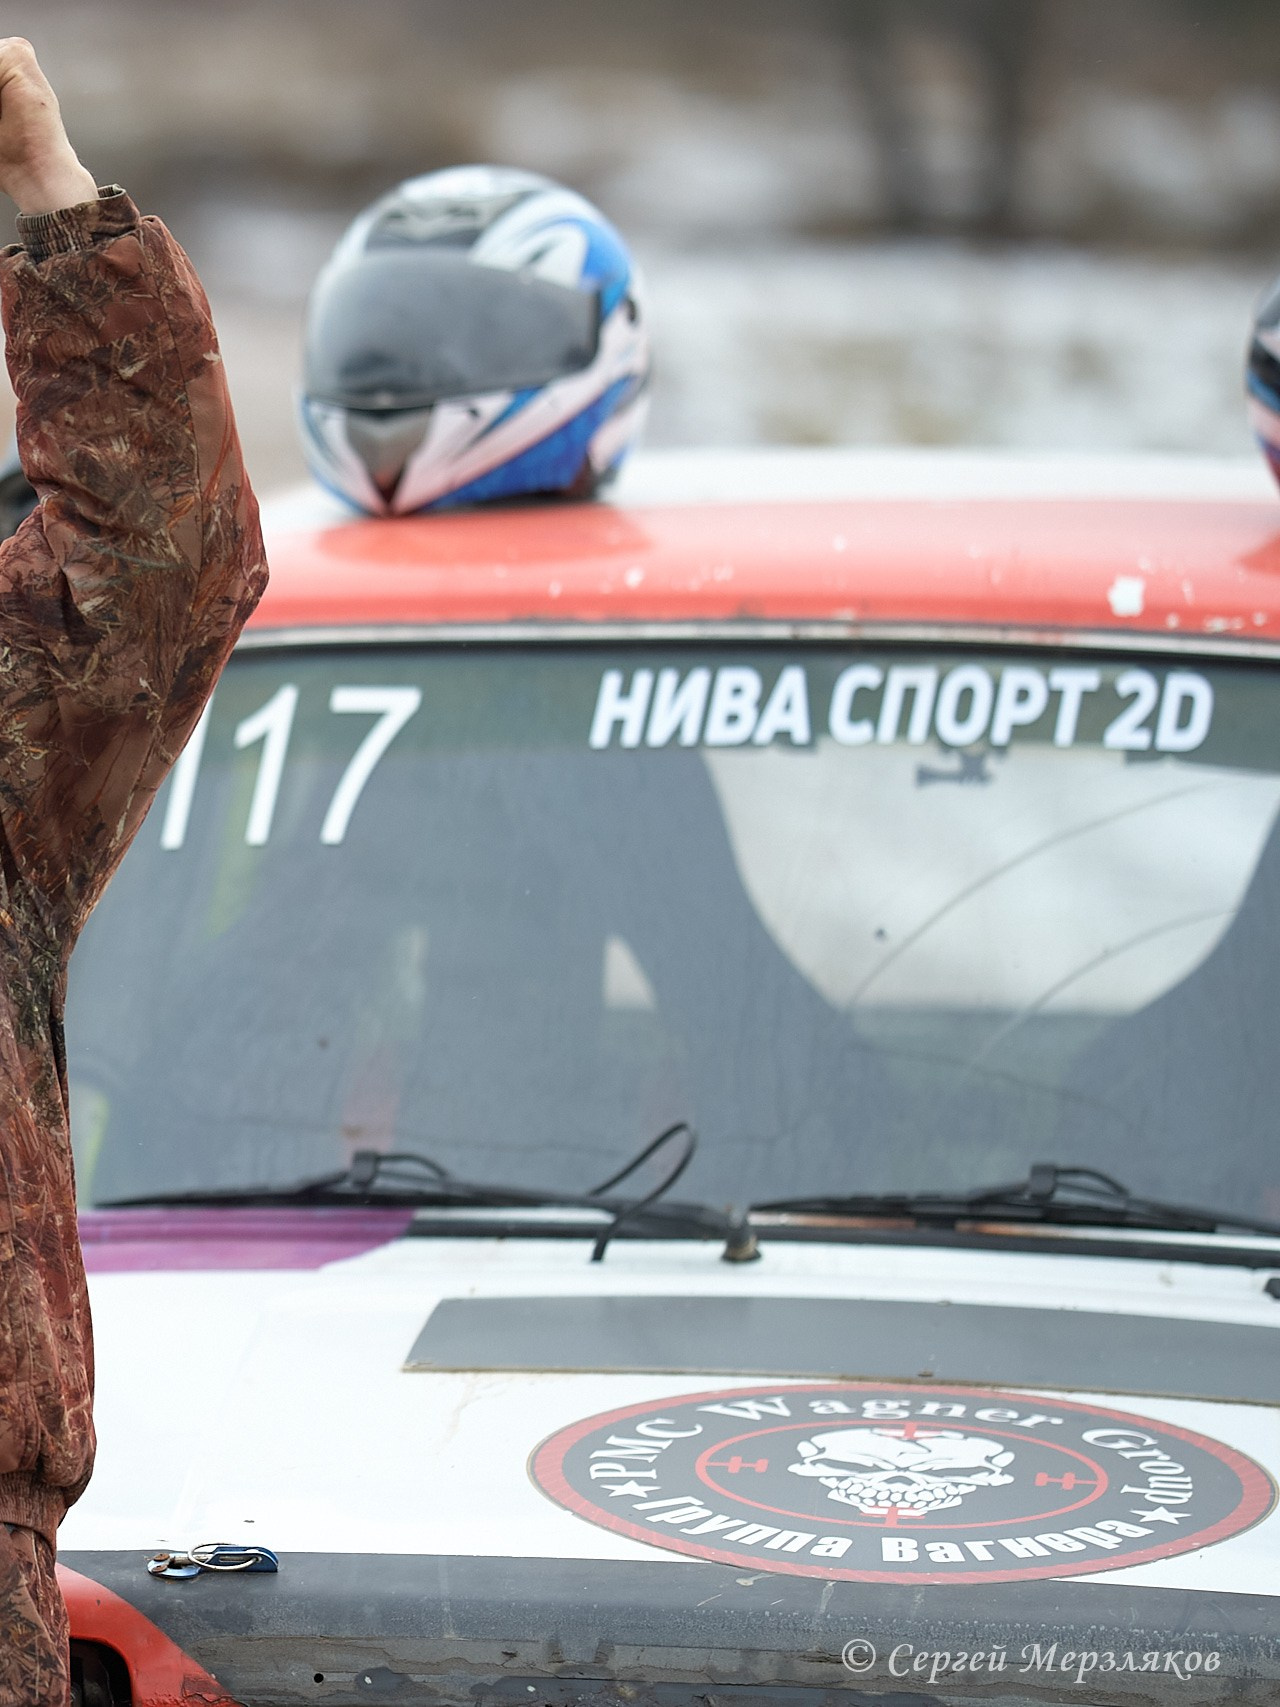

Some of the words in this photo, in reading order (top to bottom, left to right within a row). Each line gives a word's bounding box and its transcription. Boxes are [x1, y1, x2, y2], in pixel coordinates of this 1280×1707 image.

[589, 666, 811, 749] НИВА
[828, 664, 1099, 748] СПОРТ
[1103, 669, 1214, 752] 2D
[589, 1417, 704, 1482] PMC
[696, 1394, 1064, 1431] Wagner
[1080, 1426, 1195, 1507] Group
[631, 1494, 850, 1560] Группа
[881, 1516, 1154, 1564] Вагнера
